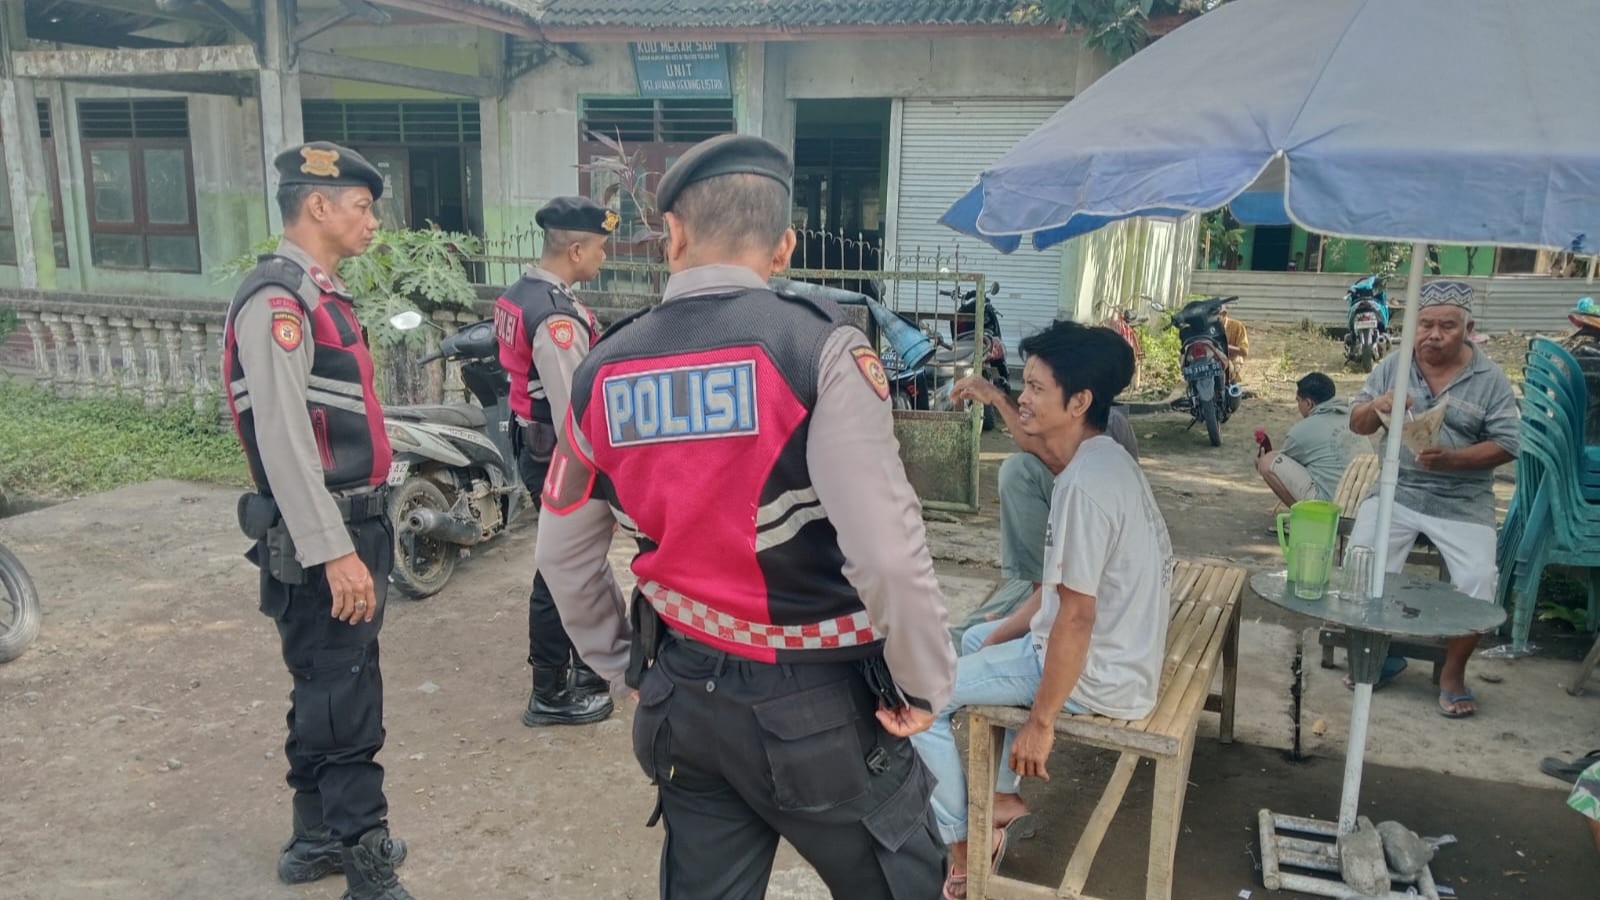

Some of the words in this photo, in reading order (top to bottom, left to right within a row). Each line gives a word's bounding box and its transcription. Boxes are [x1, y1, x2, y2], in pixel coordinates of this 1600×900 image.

[661, 40, 692, 53] MEKAR
[696, 40, 717, 52] SARI
[666, 64, 692, 77] UNIT
[494, 306, 518, 346] POLISI
[605, 366, 753, 442] POLISI
